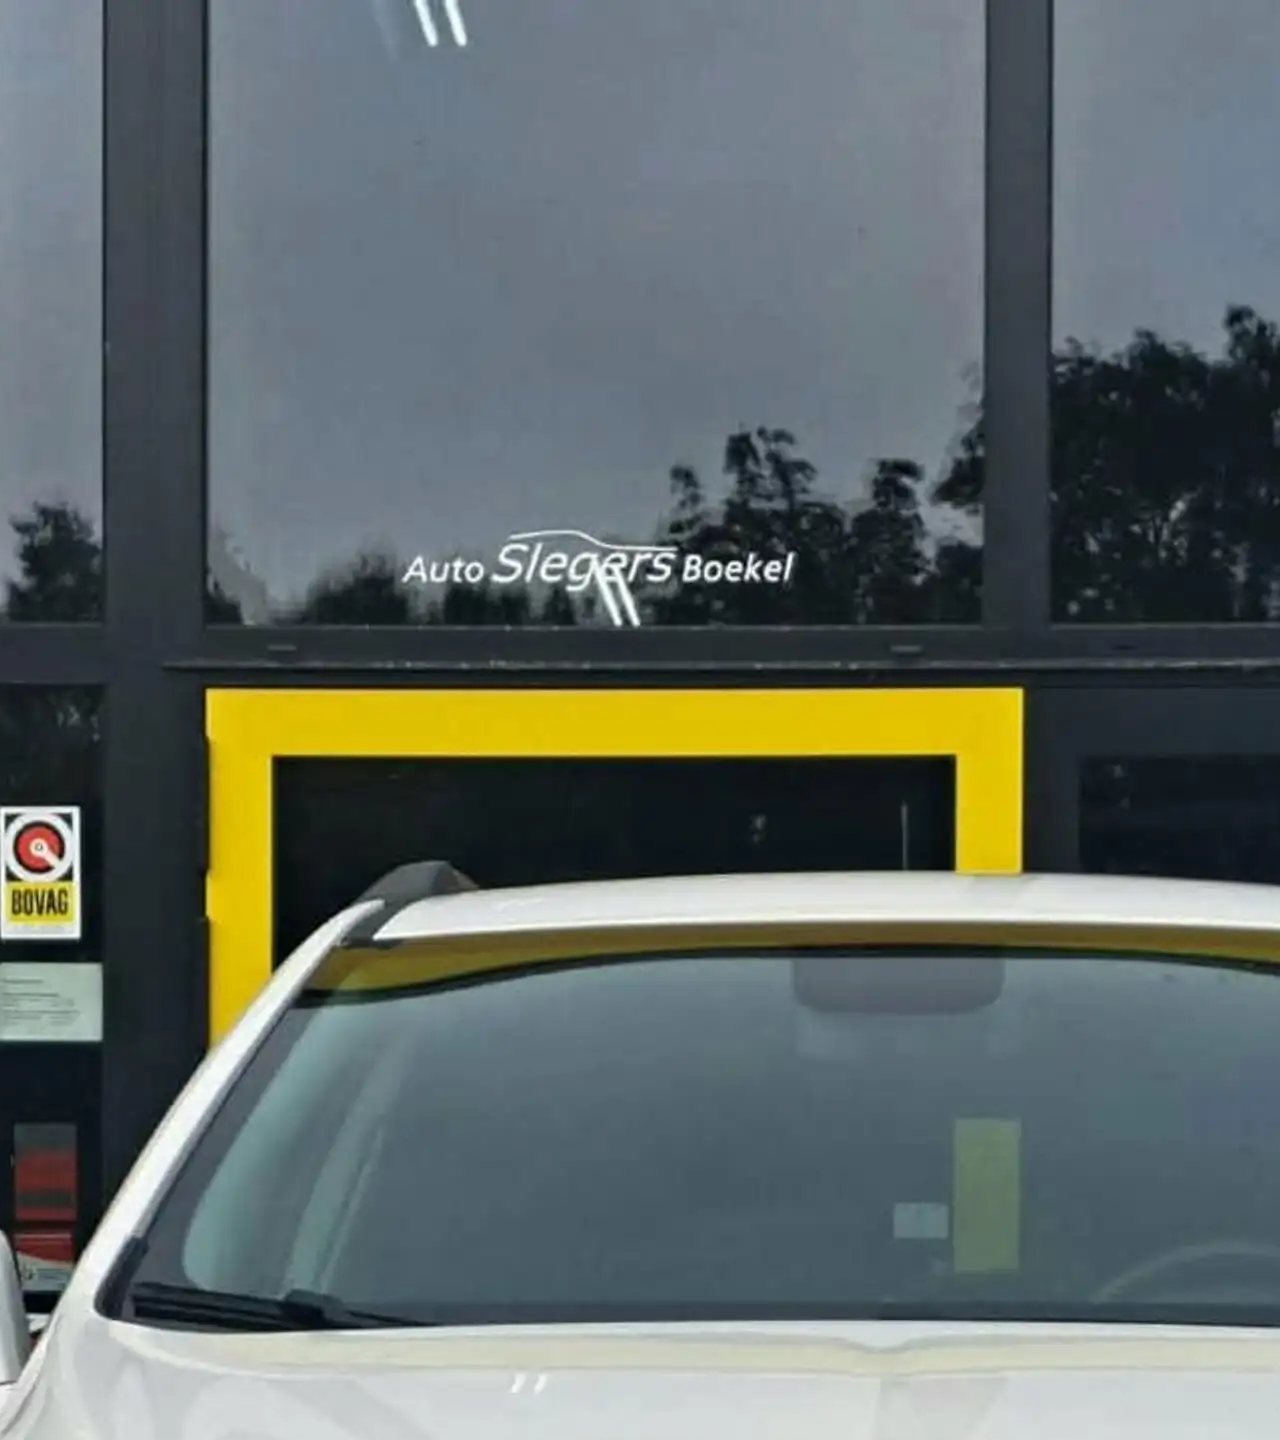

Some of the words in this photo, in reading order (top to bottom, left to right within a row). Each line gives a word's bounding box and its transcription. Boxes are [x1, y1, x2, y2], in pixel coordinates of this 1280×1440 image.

[402, 556, 484, 584] Auto
[491, 542, 675, 592] Slegers
[682, 551, 795, 583] Boekel
[11, 888, 70, 916] BOVAG
